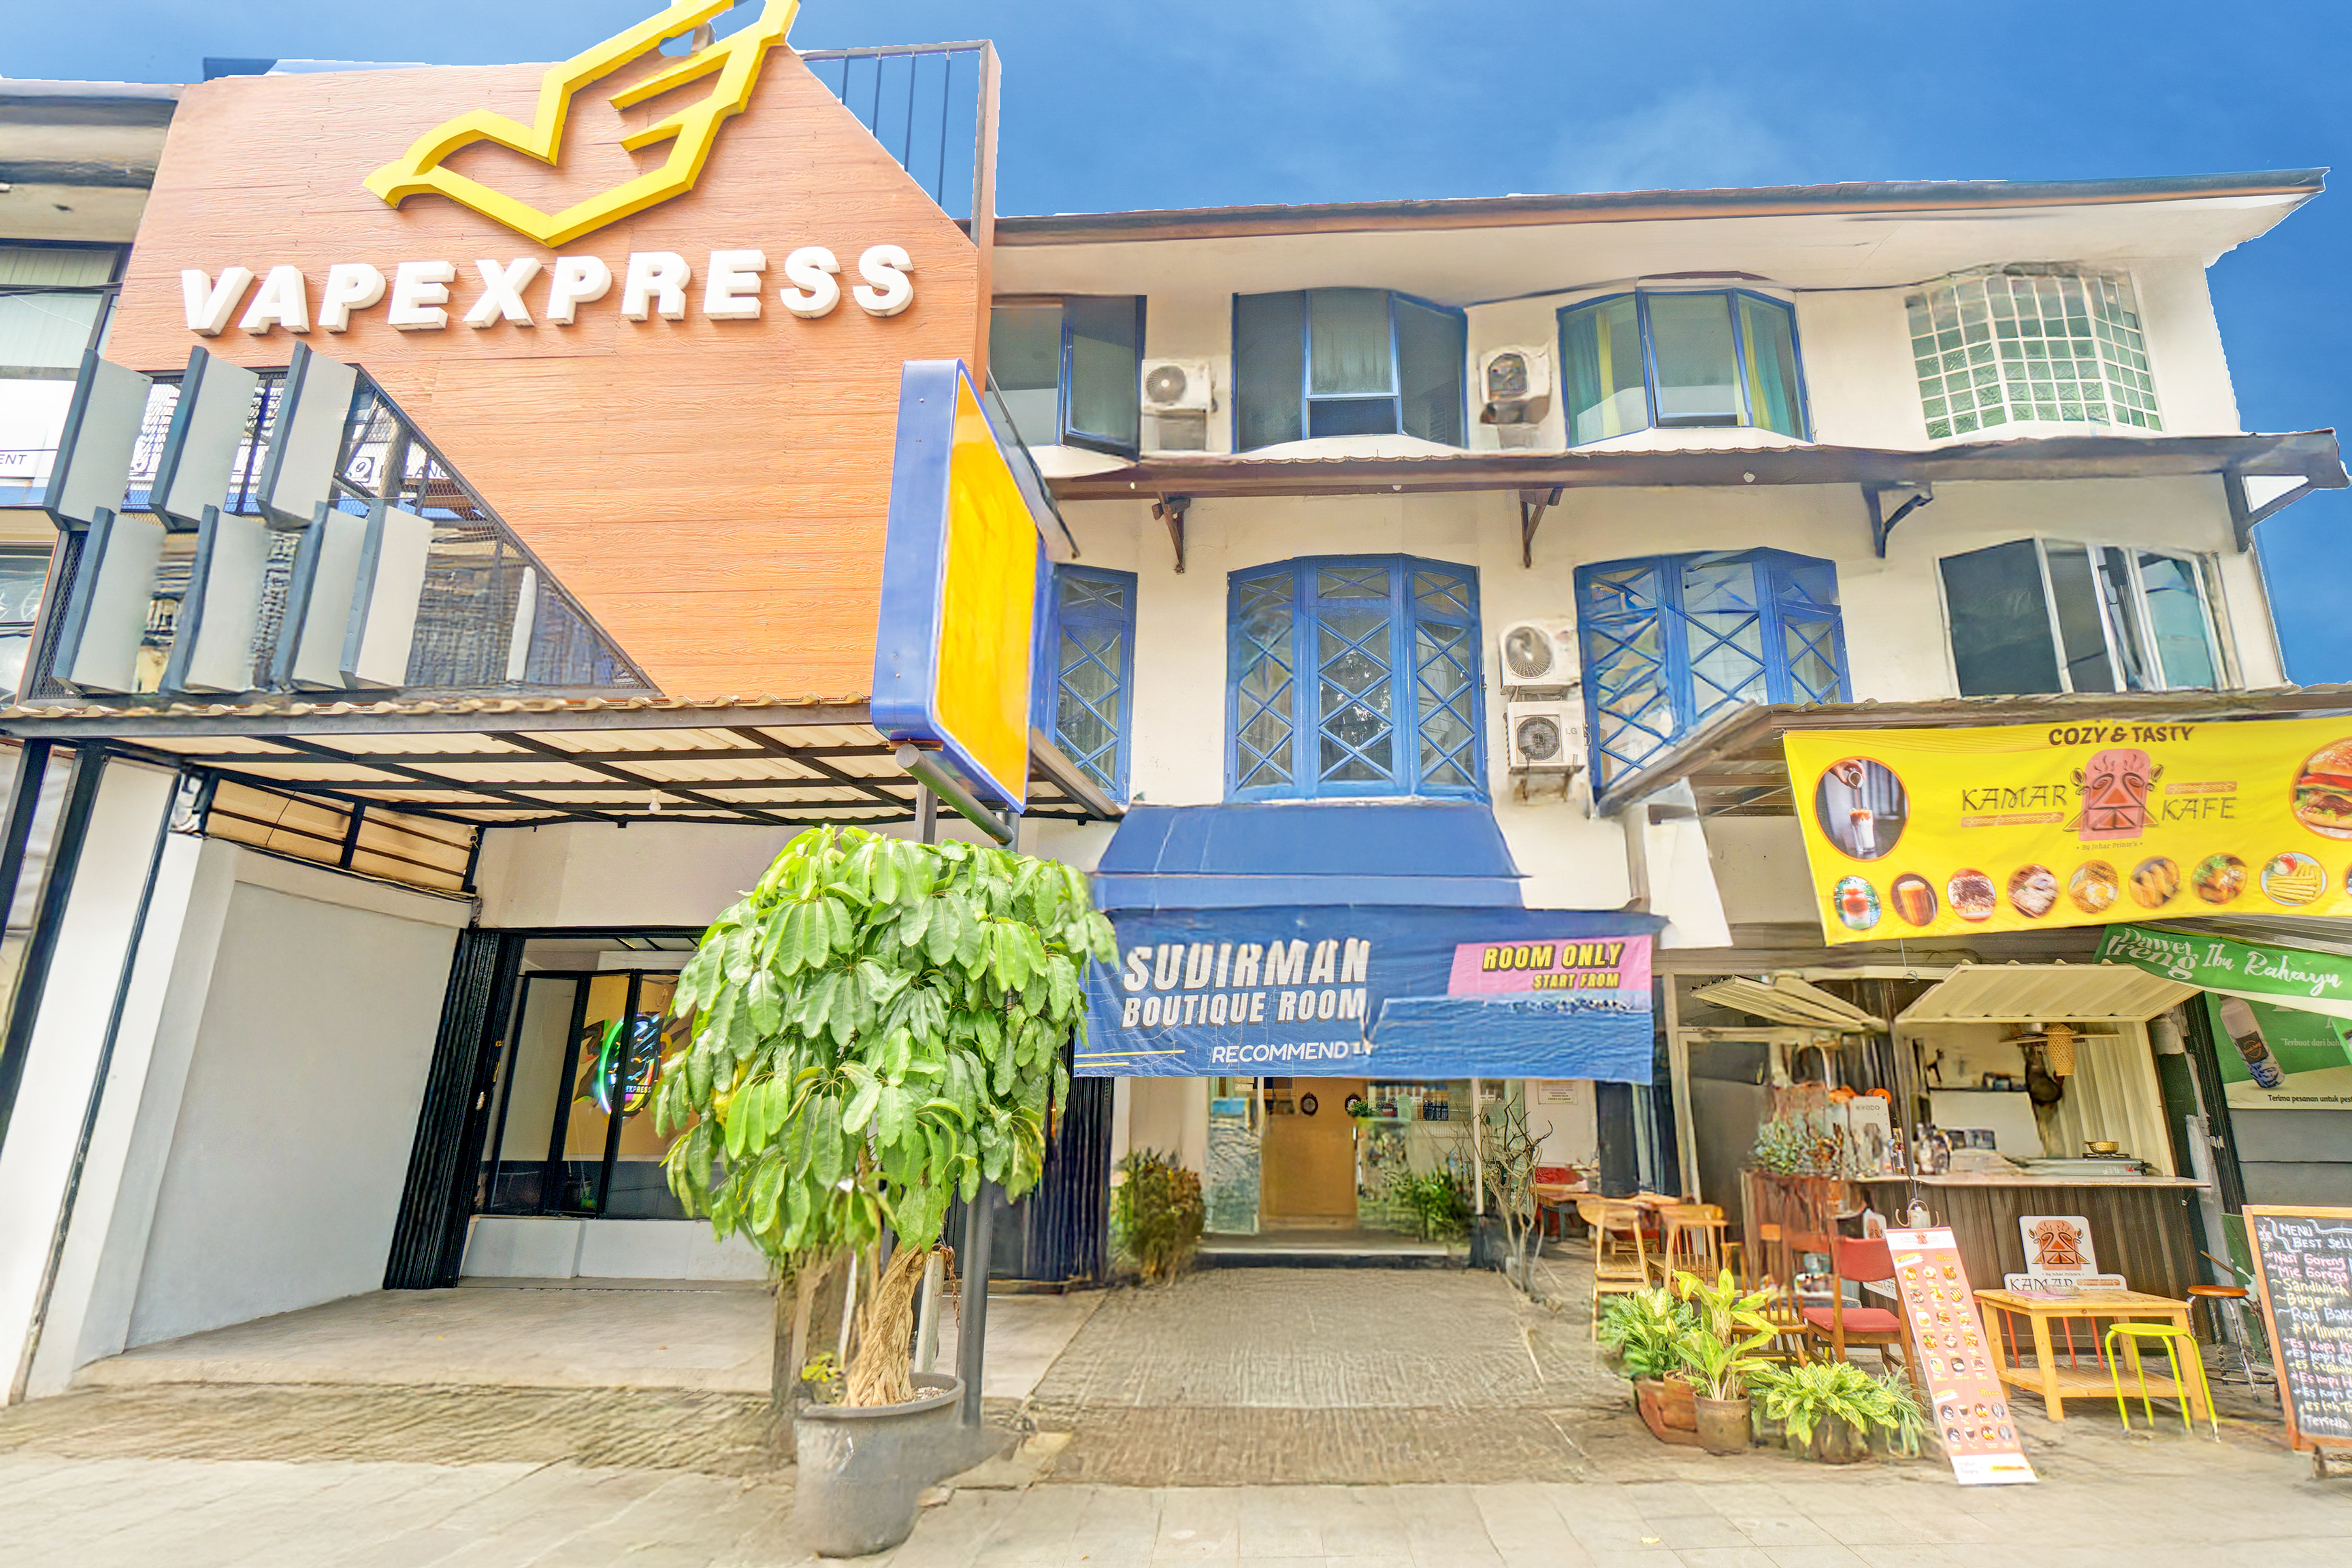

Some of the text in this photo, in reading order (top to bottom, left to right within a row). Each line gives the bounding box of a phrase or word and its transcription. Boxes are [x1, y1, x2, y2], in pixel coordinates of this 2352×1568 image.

[181, 244, 914, 337] VAPEXPRESS
[1565, 727, 1578, 735] LG
[2048, 725, 2195, 746] COZY & TASTY
[1961, 784, 2068, 811] KAMAR
[2161, 796, 2238, 821] KAFE
[2120, 928, 2193, 956] Dawet
[1122, 938, 1371, 992] SUDIRMAN
[1482, 943, 1625, 972] ROOM ONLY
[2105, 935, 2198, 979] Ireng
[2202, 943, 2342, 996] Ibu Rahayu
[1533, 973, 1620, 990] START FROM
[1121, 988, 1367, 1030] BOUTIQUE ROOM
[2311, 1038, 2325, 1046] dari
[2278, 1223, 2314, 1237] MENU
[2291, 1237, 2322, 1248] BEST
[2286, 1292, 2330, 1311] Burger
